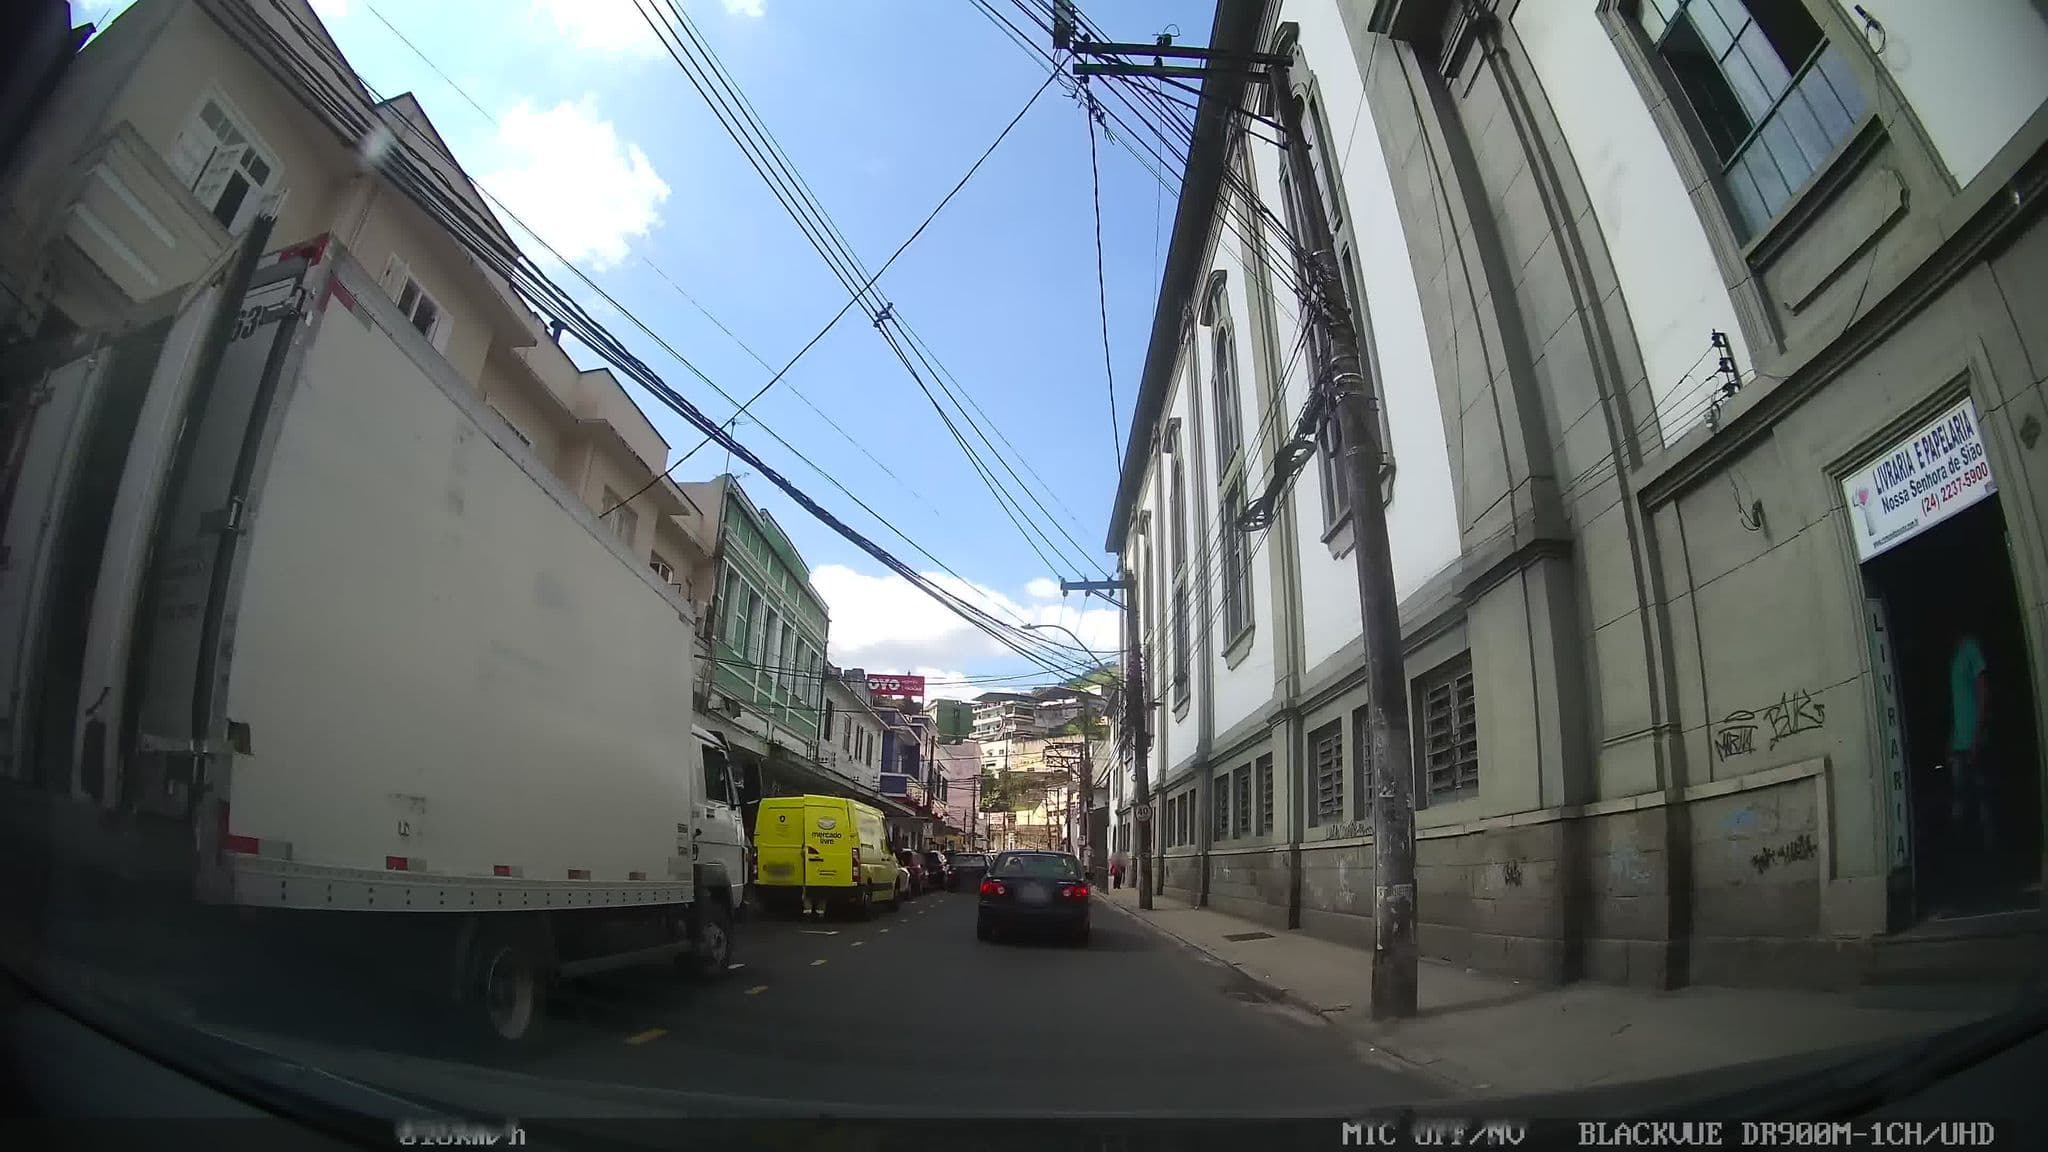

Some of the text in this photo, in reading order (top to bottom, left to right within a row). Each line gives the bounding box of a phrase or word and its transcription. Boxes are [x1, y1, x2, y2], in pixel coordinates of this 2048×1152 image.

[1872, 409, 1975, 495] LIVRARIA E PAPELARIA
[1880, 440, 1983, 516] Nossa Senhora de Sião
[1920, 461, 1989, 518] (24) 2237-5900
[867, 678, 901, 691] OYO
[1871, 612, 1906, 857] LIVRARIA
[811, 831, 842, 839] mercado
